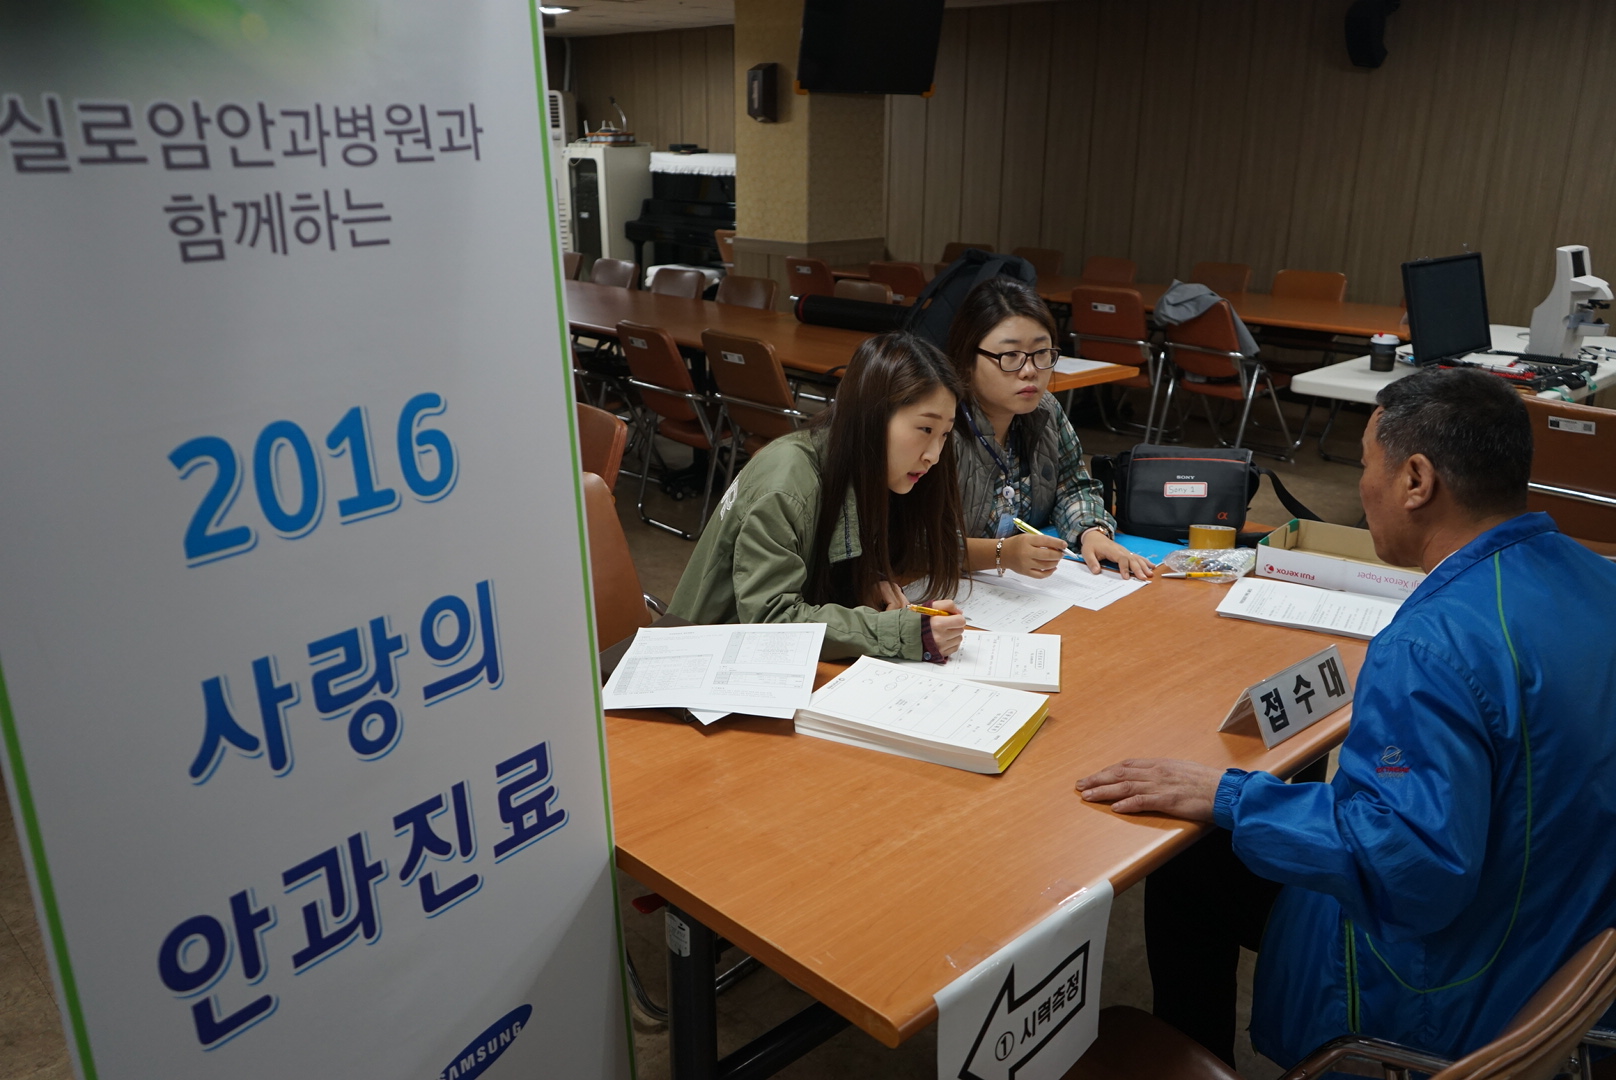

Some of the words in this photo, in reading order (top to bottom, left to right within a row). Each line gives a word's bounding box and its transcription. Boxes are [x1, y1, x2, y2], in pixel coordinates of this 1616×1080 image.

[0, 97, 484, 174] 실로암안과병원과
[163, 189, 391, 263] 함께하는
[167, 392, 459, 567] 2016
[1357, 571, 1382, 584] Paper
[1384, 576, 1410, 589] Xerox
[188, 579, 503, 785] 사랑의
[1260, 656, 1346, 733] 접수대
[157, 741, 569, 1051] 안과진료
[1020, 970, 1080, 1045] 시력측정
